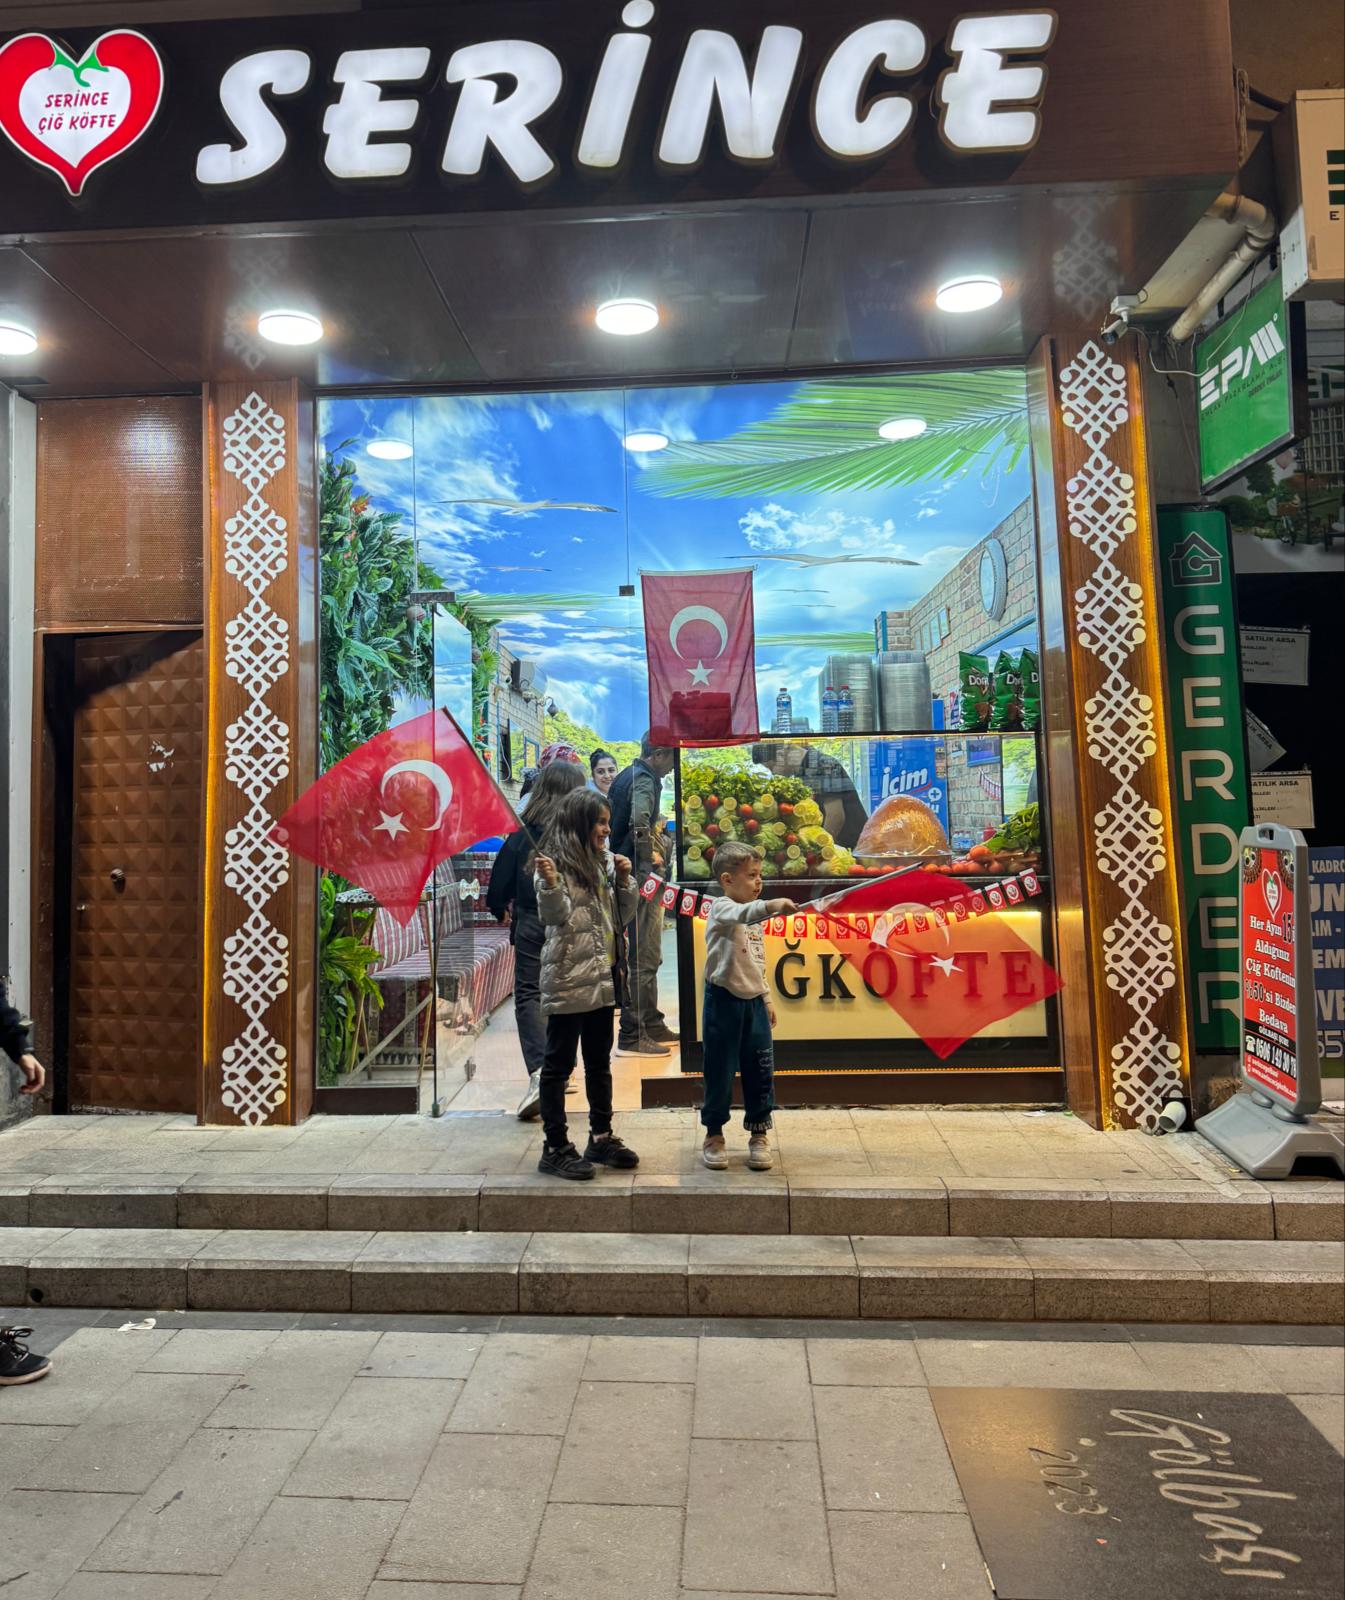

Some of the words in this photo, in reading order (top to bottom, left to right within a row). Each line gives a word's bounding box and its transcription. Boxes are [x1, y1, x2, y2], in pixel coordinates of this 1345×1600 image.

[45, 89, 109, 108] SERİNCE
[196, 0, 1055, 185] SERİNCE
[38, 113, 64, 135] ÇİĞ
[69, 112, 116, 130] KÖFTE
[1250, 915, 1264, 930] Her
[1246, 957, 1261, 976] Çiğ
[1259, 1008, 1289, 1033] Bedava
[1028, 1447, 1108, 1514] 2023
